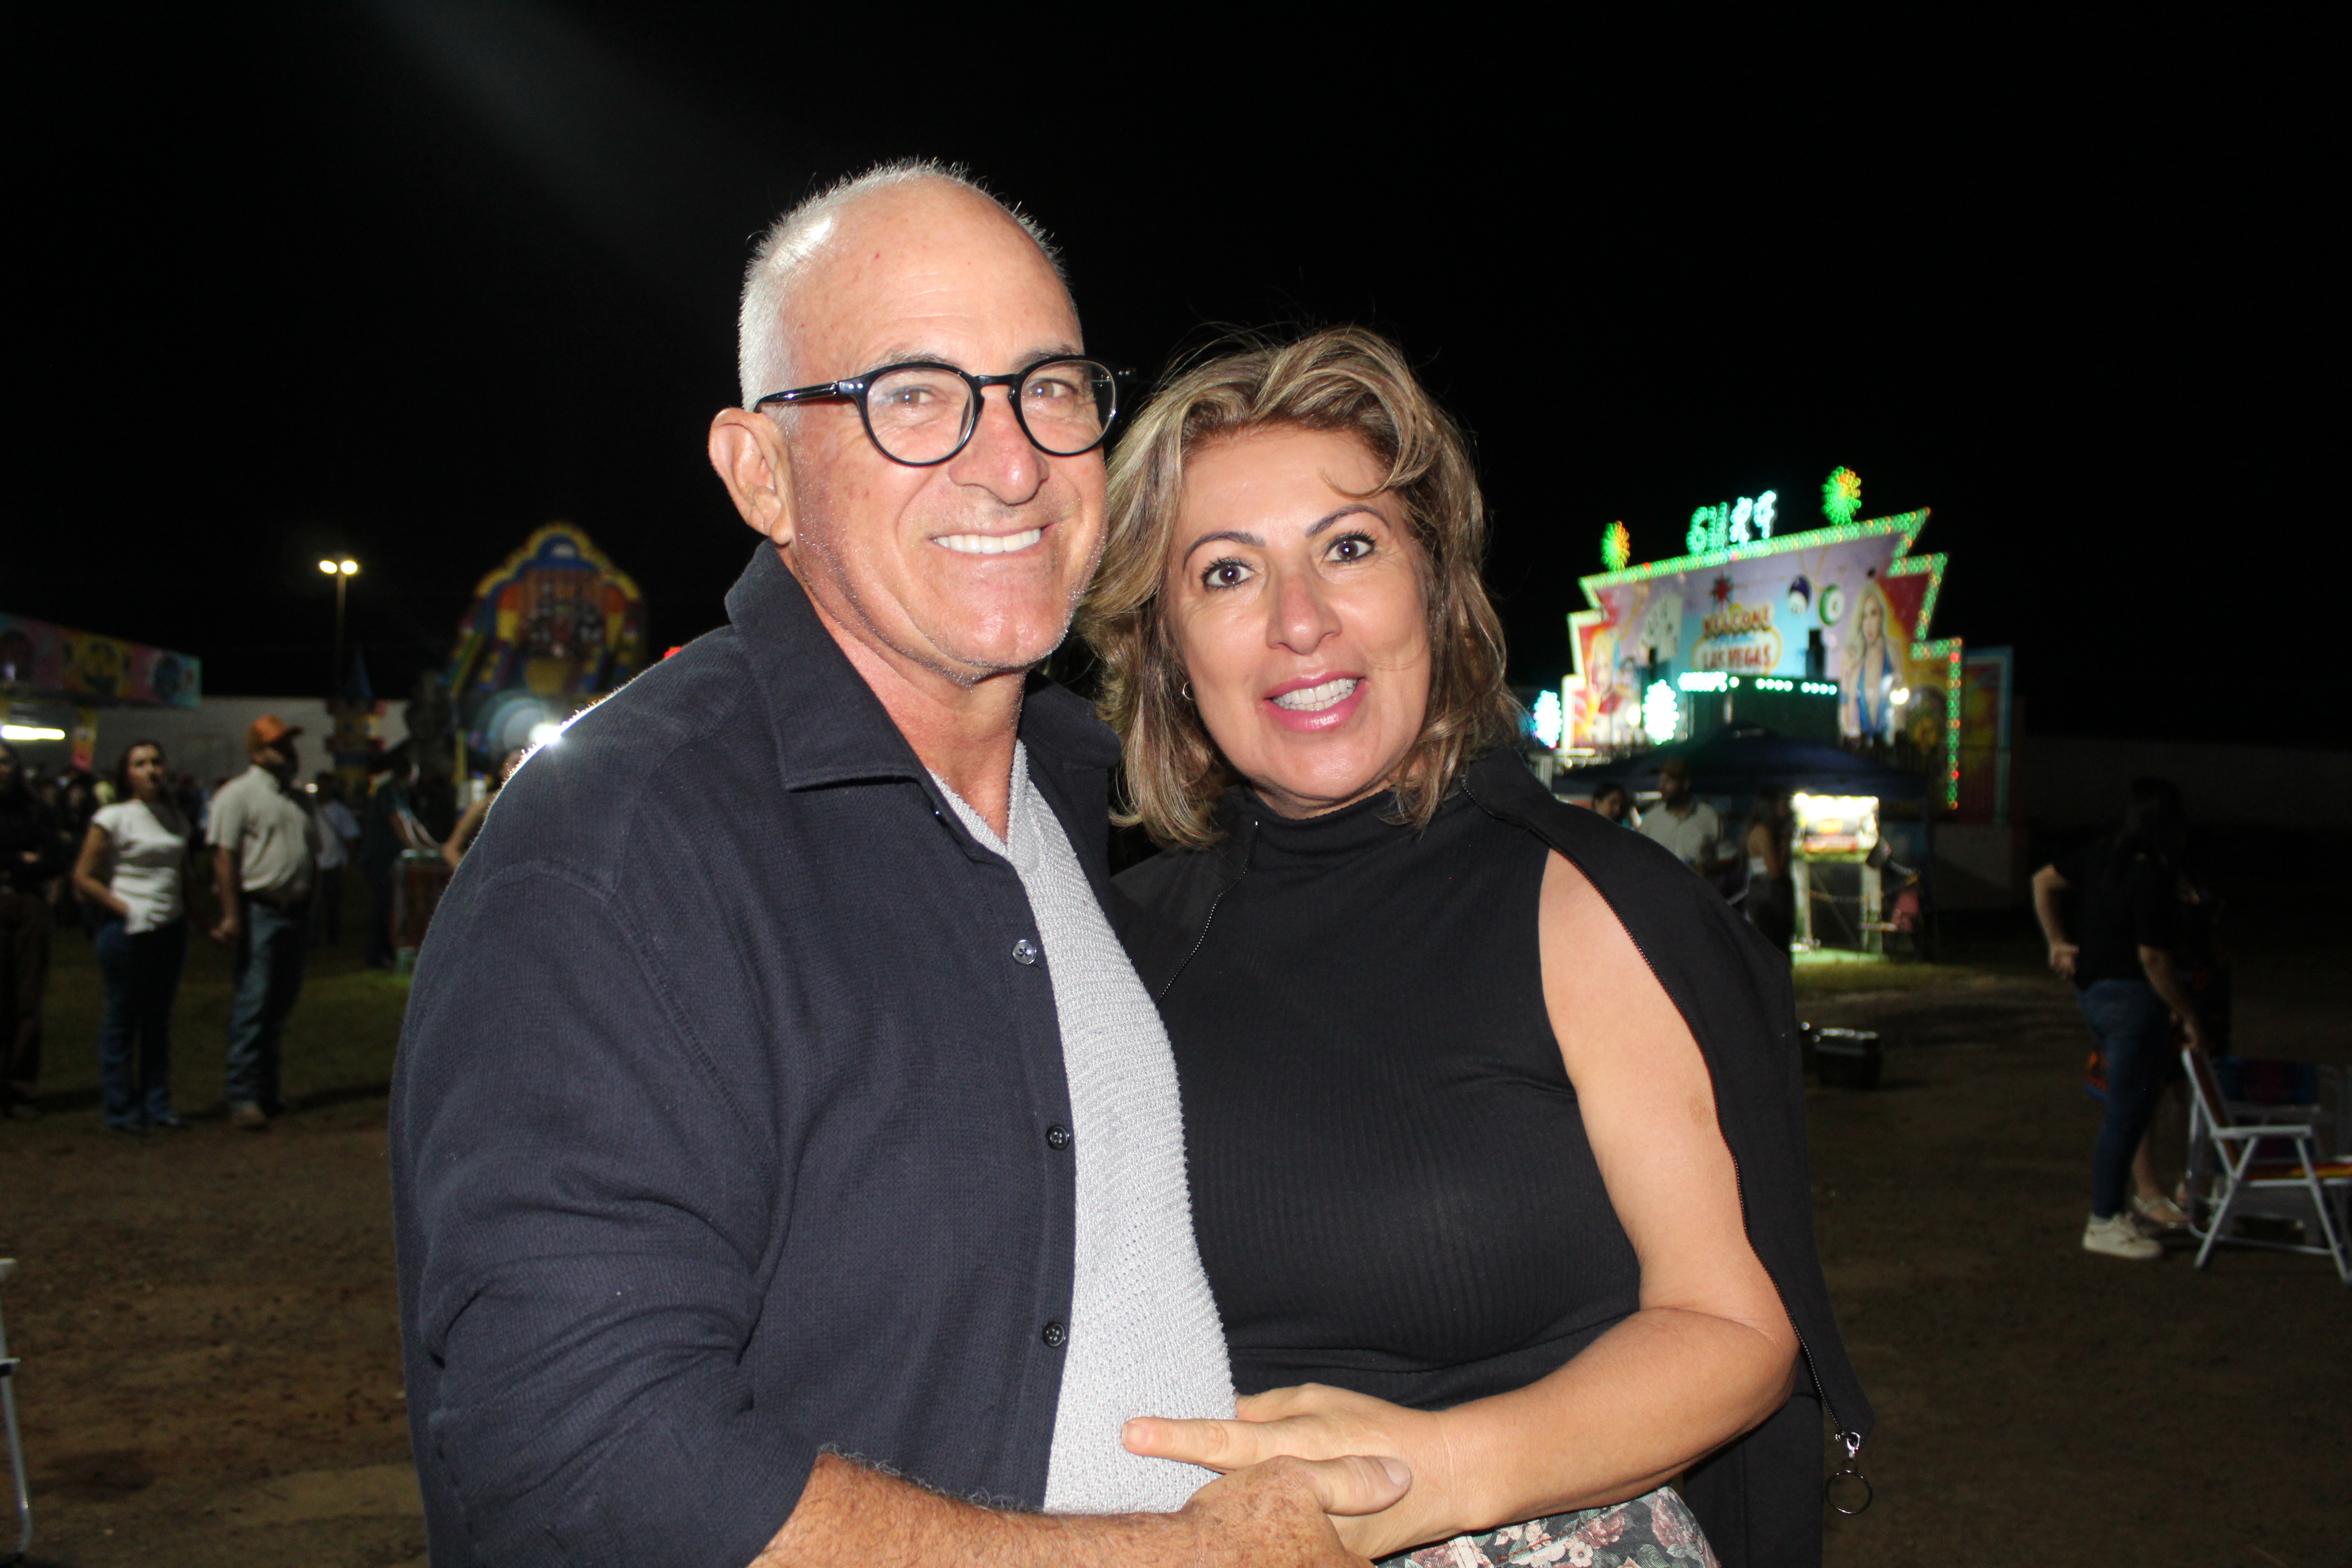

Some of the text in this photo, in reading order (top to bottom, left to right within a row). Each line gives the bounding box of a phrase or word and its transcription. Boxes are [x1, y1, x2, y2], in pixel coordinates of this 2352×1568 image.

[1704, 607, 1770, 632] WELCOME
[1702, 644, 1771, 671] LAS VEGAS
